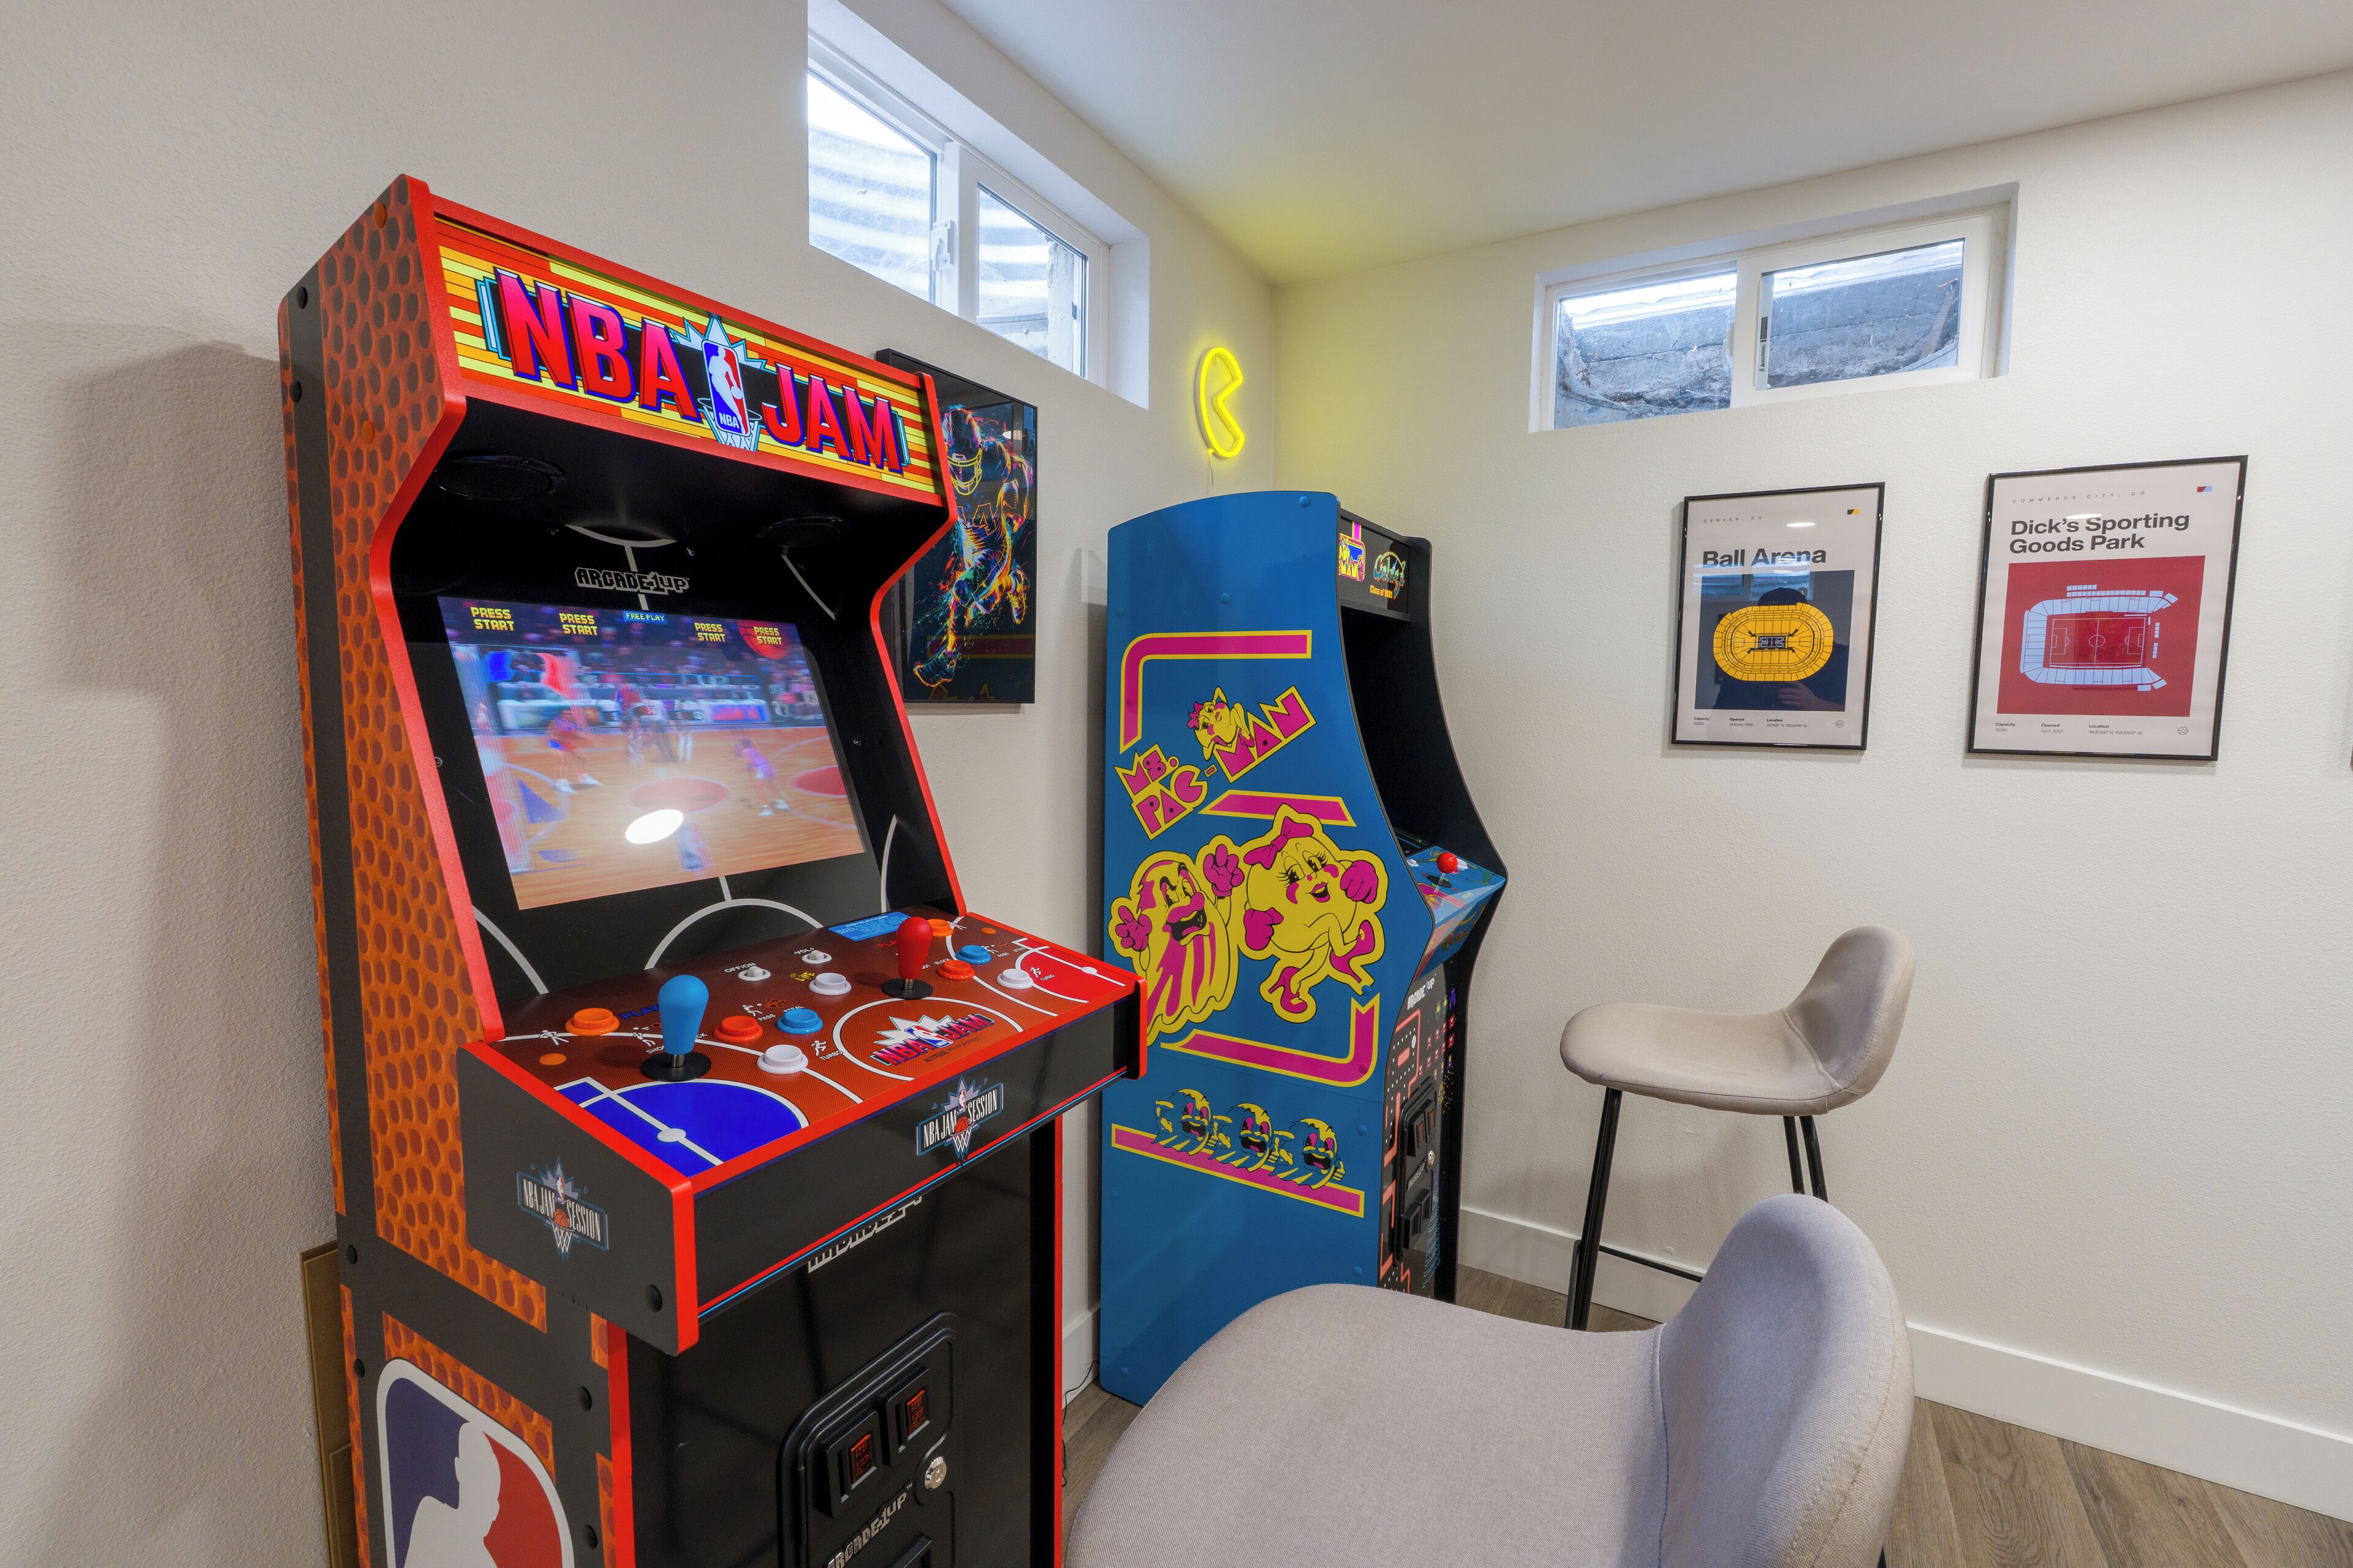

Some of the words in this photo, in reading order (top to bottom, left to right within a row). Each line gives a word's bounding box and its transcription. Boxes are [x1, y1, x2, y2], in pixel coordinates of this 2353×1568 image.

[493, 267, 702, 423] NBA
[762, 362, 903, 473] JAM
[718, 412, 740, 429] NBA
[2010, 517, 2080, 536] Dick's
[2085, 513, 2190, 536] Sporting
[2009, 536, 2085, 554] Goods
[2090, 533, 2146, 551] Park
[1703, 549, 1745, 569] Ball
[1751, 548, 1827, 567] Arena
[1370, 585, 1380, 595] Class
[1384, 589, 1393, 599] 1981
[471, 607, 512, 619] PRESS
[559, 613, 595, 624] PRESS
[474, 619, 514, 631] START
[563, 624, 597, 635] START
[694, 622, 724, 633] PRESS
[754, 626, 780, 636] PRESS
[697, 632, 726, 642] START
[756, 636, 782, 645] START
[724, 962, 757, 973] OFF/ON
[872, 1037, 936, 1066] NBA
[936, 1013, 995, 1040] JAM
[819, 1050, 843, 1061] TURBO
[923, 1119, 940, 1148] NBA
[968, 1089, 997, 1124] SESSION
[523, 1178, 539, 1211] NBA
[566, 1199, 601, 1242] SESSION
